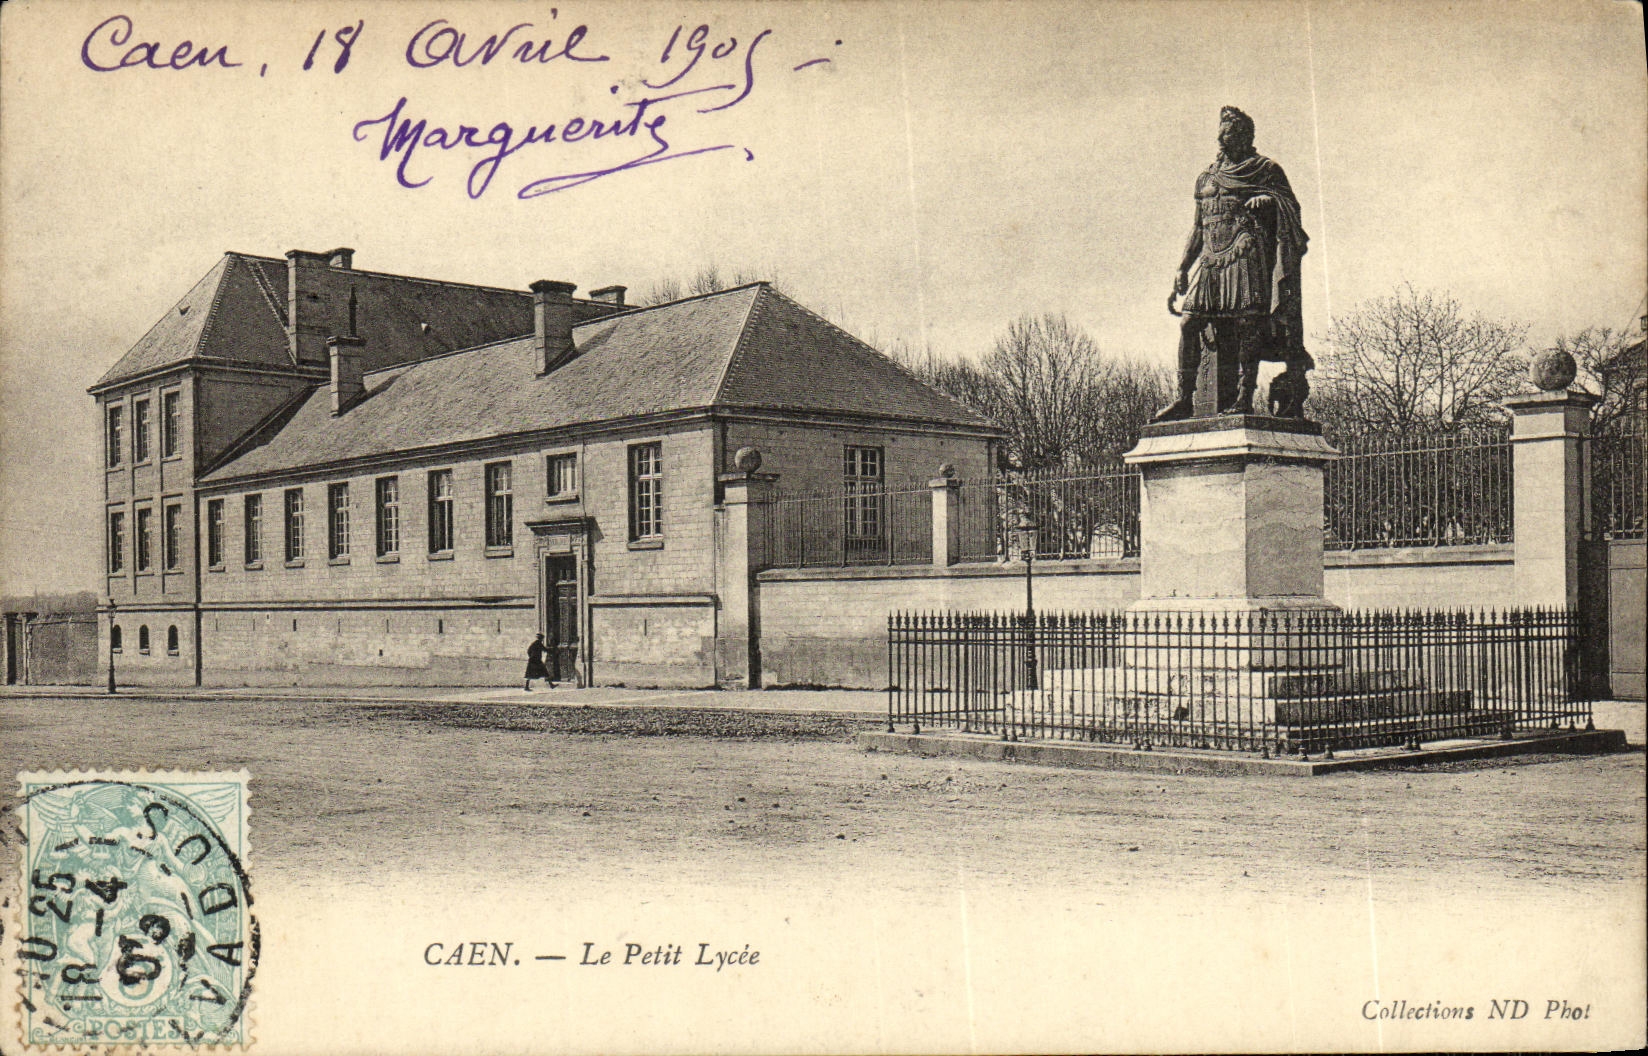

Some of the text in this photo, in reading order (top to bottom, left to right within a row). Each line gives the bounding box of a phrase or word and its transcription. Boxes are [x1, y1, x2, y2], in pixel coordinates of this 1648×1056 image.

[302, 19, 365, 74] 18
[642, 23, 772, 114] 1905
[89, 1019, 182, 1041] POSTES
